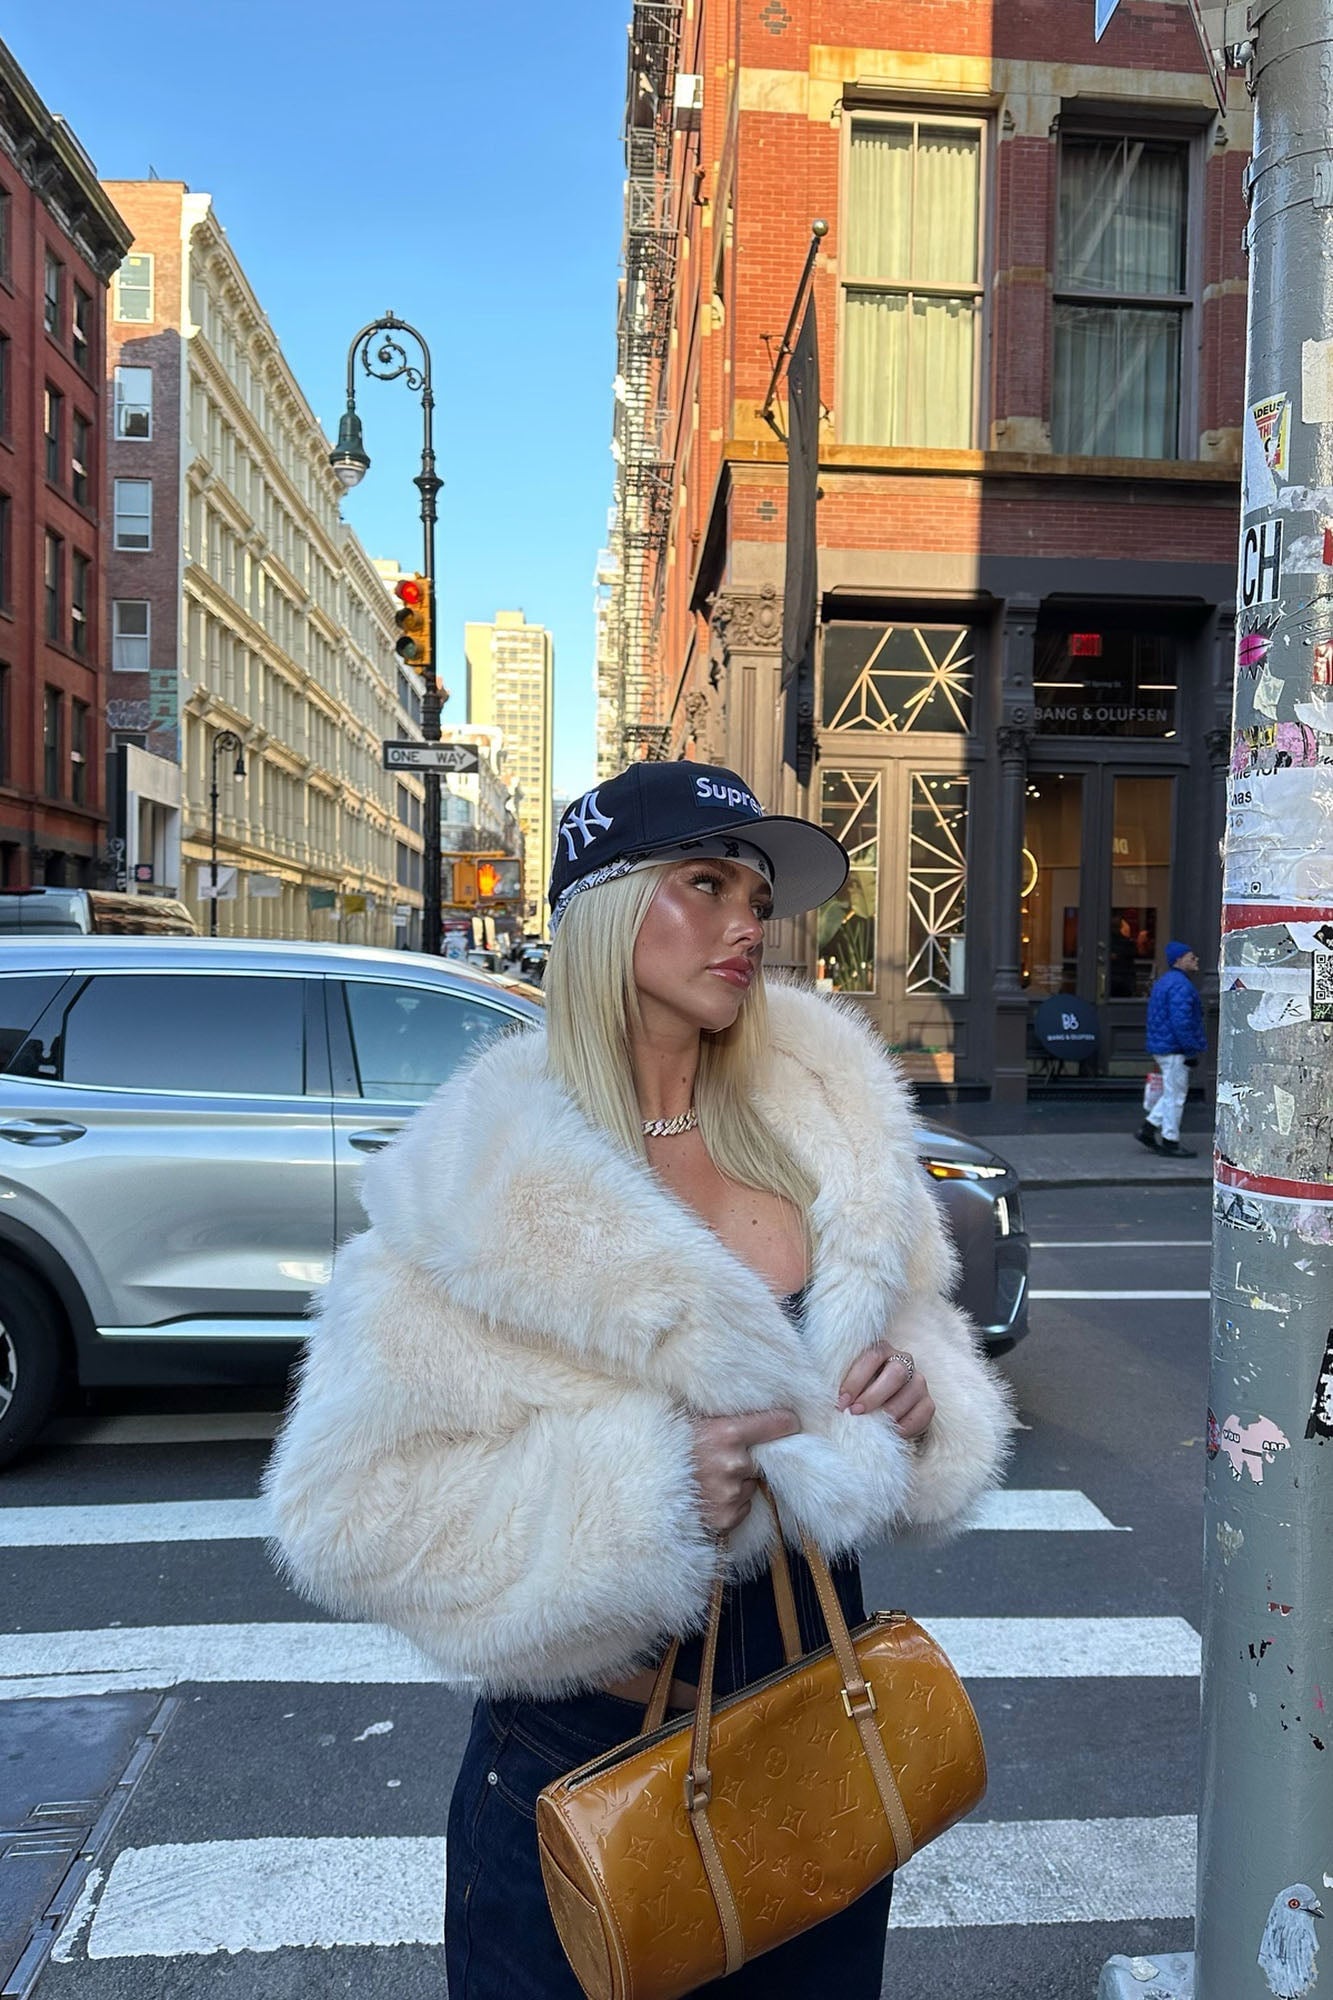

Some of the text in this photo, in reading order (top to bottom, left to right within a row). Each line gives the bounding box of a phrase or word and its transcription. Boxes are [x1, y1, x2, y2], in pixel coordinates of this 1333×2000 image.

[1034, 708, 1168, 722] BANG & OLUFSEN
[390, 750, 467, 766] ONE WAY
[560, 790, 615, 862] NY
[1222, 1429, 1241, 1444] YOU
